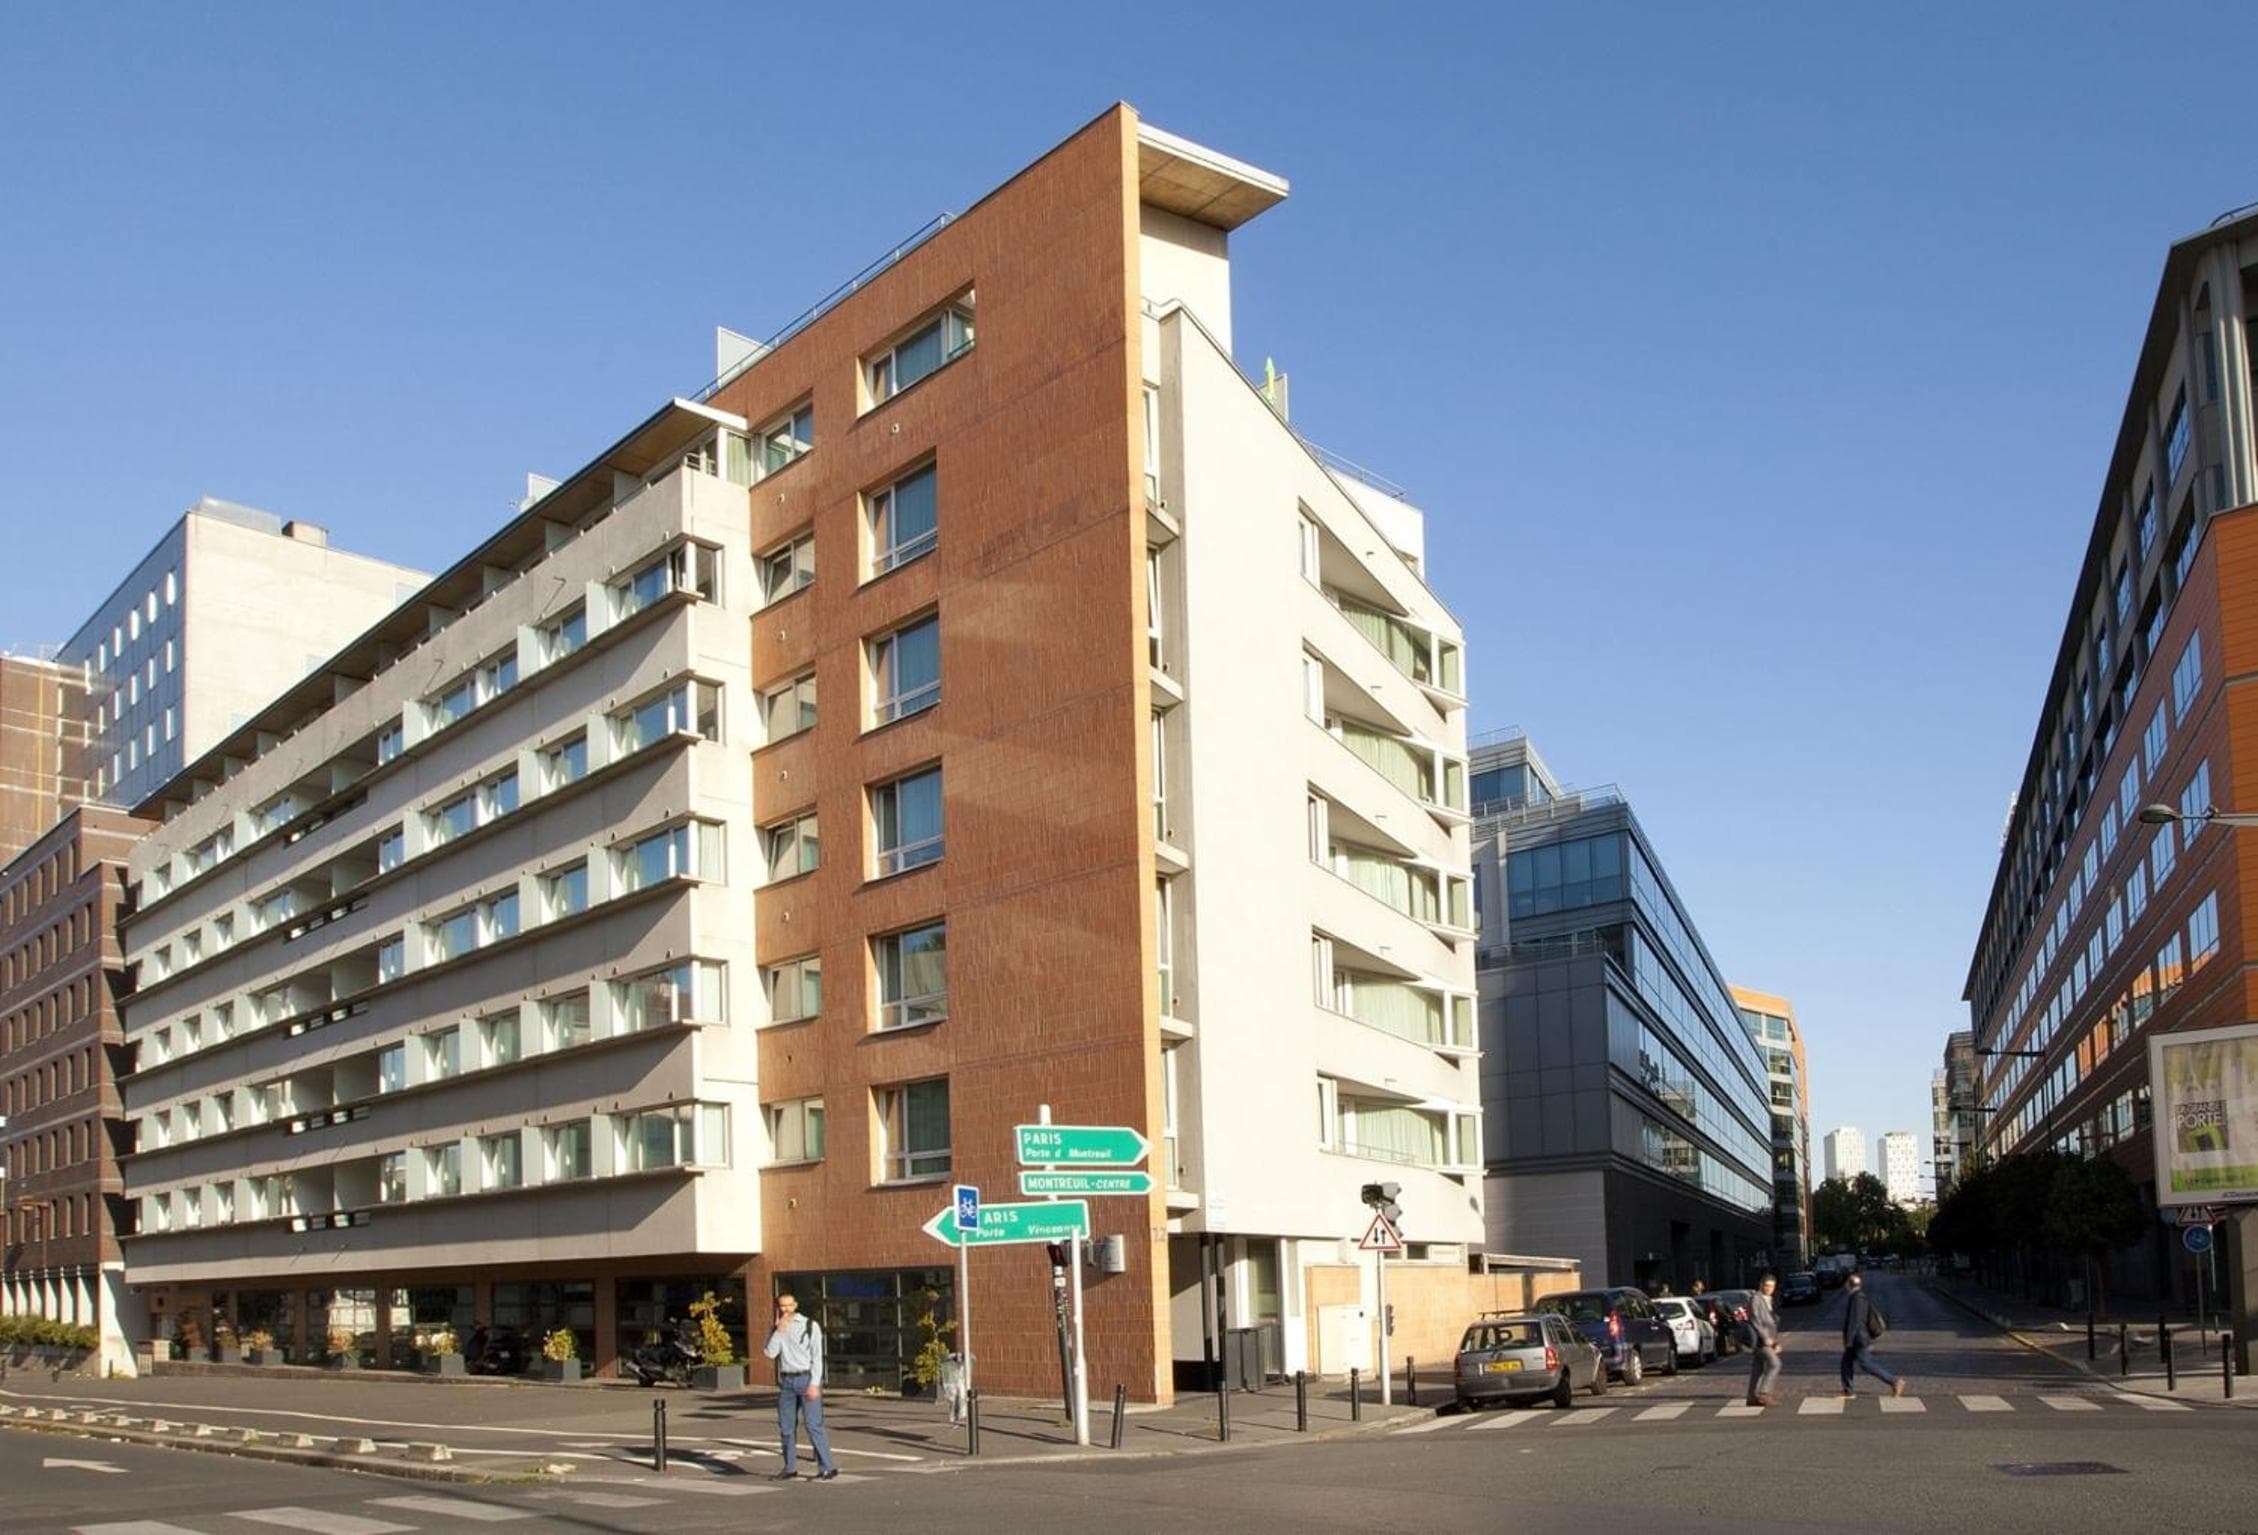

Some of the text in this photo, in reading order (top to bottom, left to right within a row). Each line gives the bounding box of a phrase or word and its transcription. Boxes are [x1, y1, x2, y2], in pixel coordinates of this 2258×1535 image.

[2177, 1111, 2223, 1129] PORTE
[1023, 1132, 1062, 1145] PARIS
[1025, 1147, 1051, 1158] Porte
[984, 1210, 1019, 1224] ARIS
